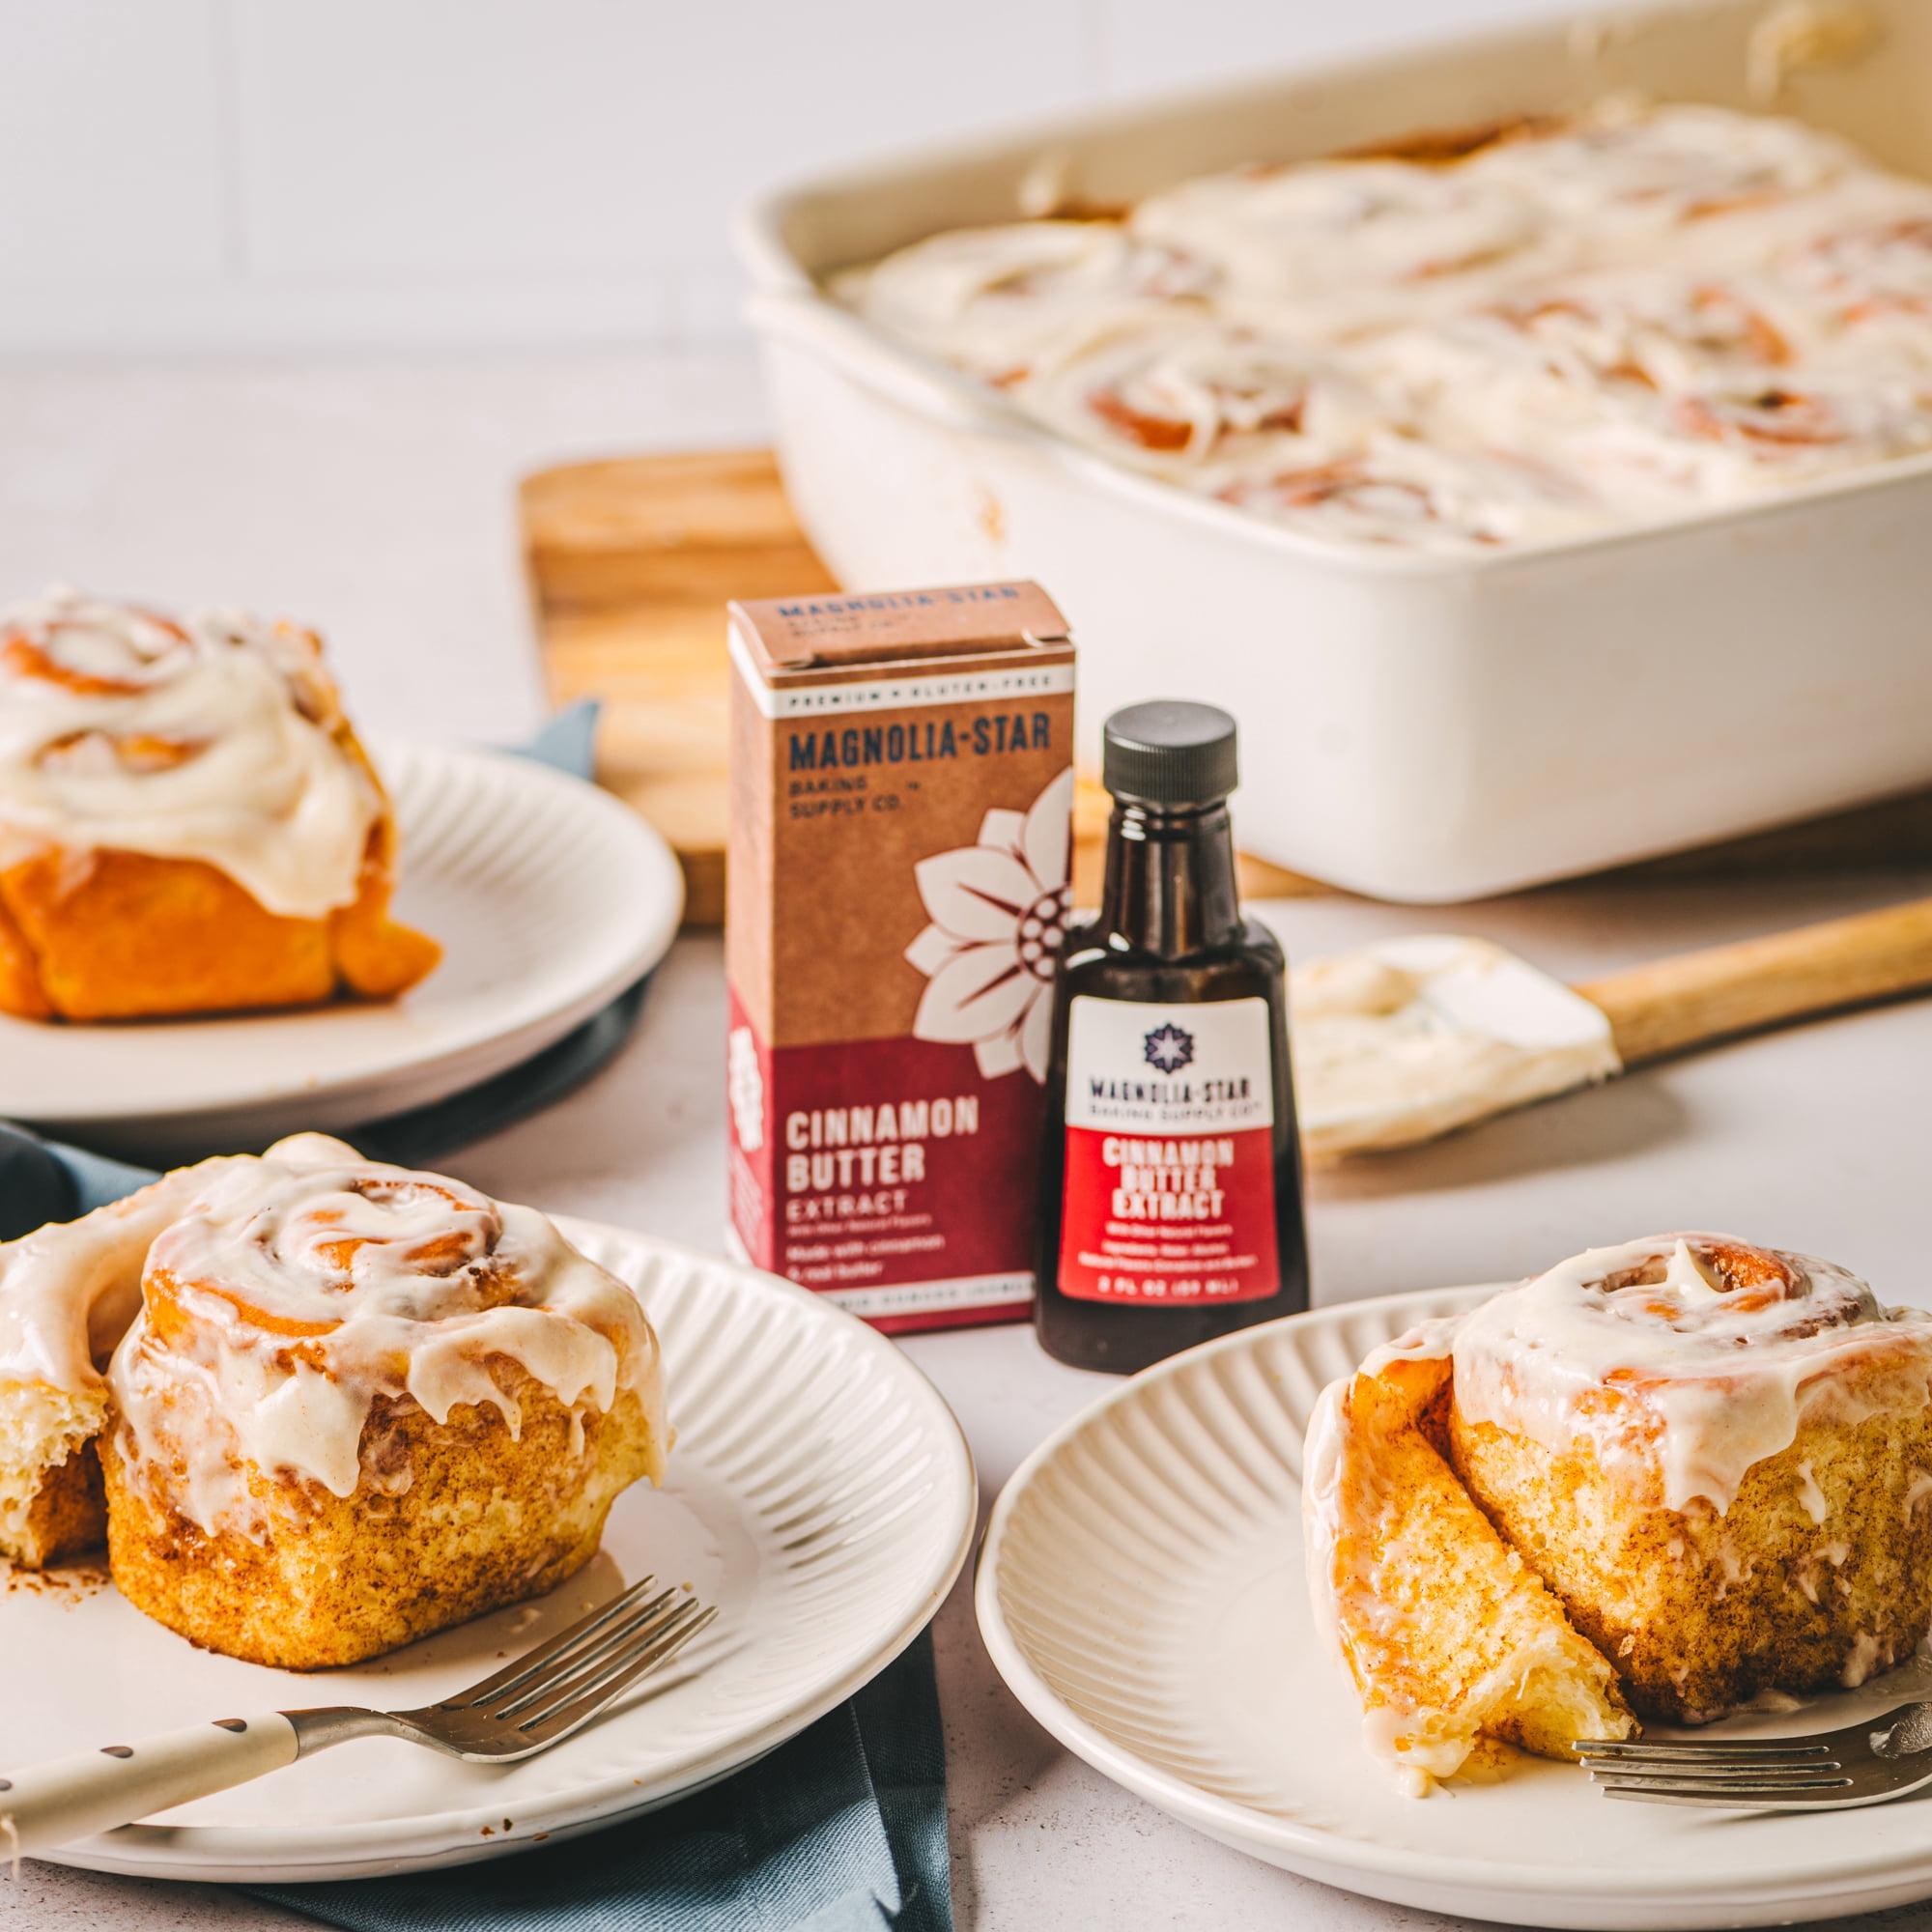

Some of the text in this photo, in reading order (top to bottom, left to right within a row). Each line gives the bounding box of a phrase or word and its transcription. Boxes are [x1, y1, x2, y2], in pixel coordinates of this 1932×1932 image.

[788, 692, 881, 707] PREMIUM
[788, 712, 1051, 772] MAGNOLIA-STAR
[788, 775, 867, 798] BAKING
[789, 797, 867, 820] SUPPLY
[786, 1095, 980, 1151] CINNAMON
[1102, 1136, 1235, 1167] CINNAMON
[786, 1143, 925, 1193] BUTTER
[1121, 1165, 1217, 1192] BUTTER
[786, 1189, 909, 1221] EXTRACT
[1112, 1188, 1226, 1219] EXTRACT
